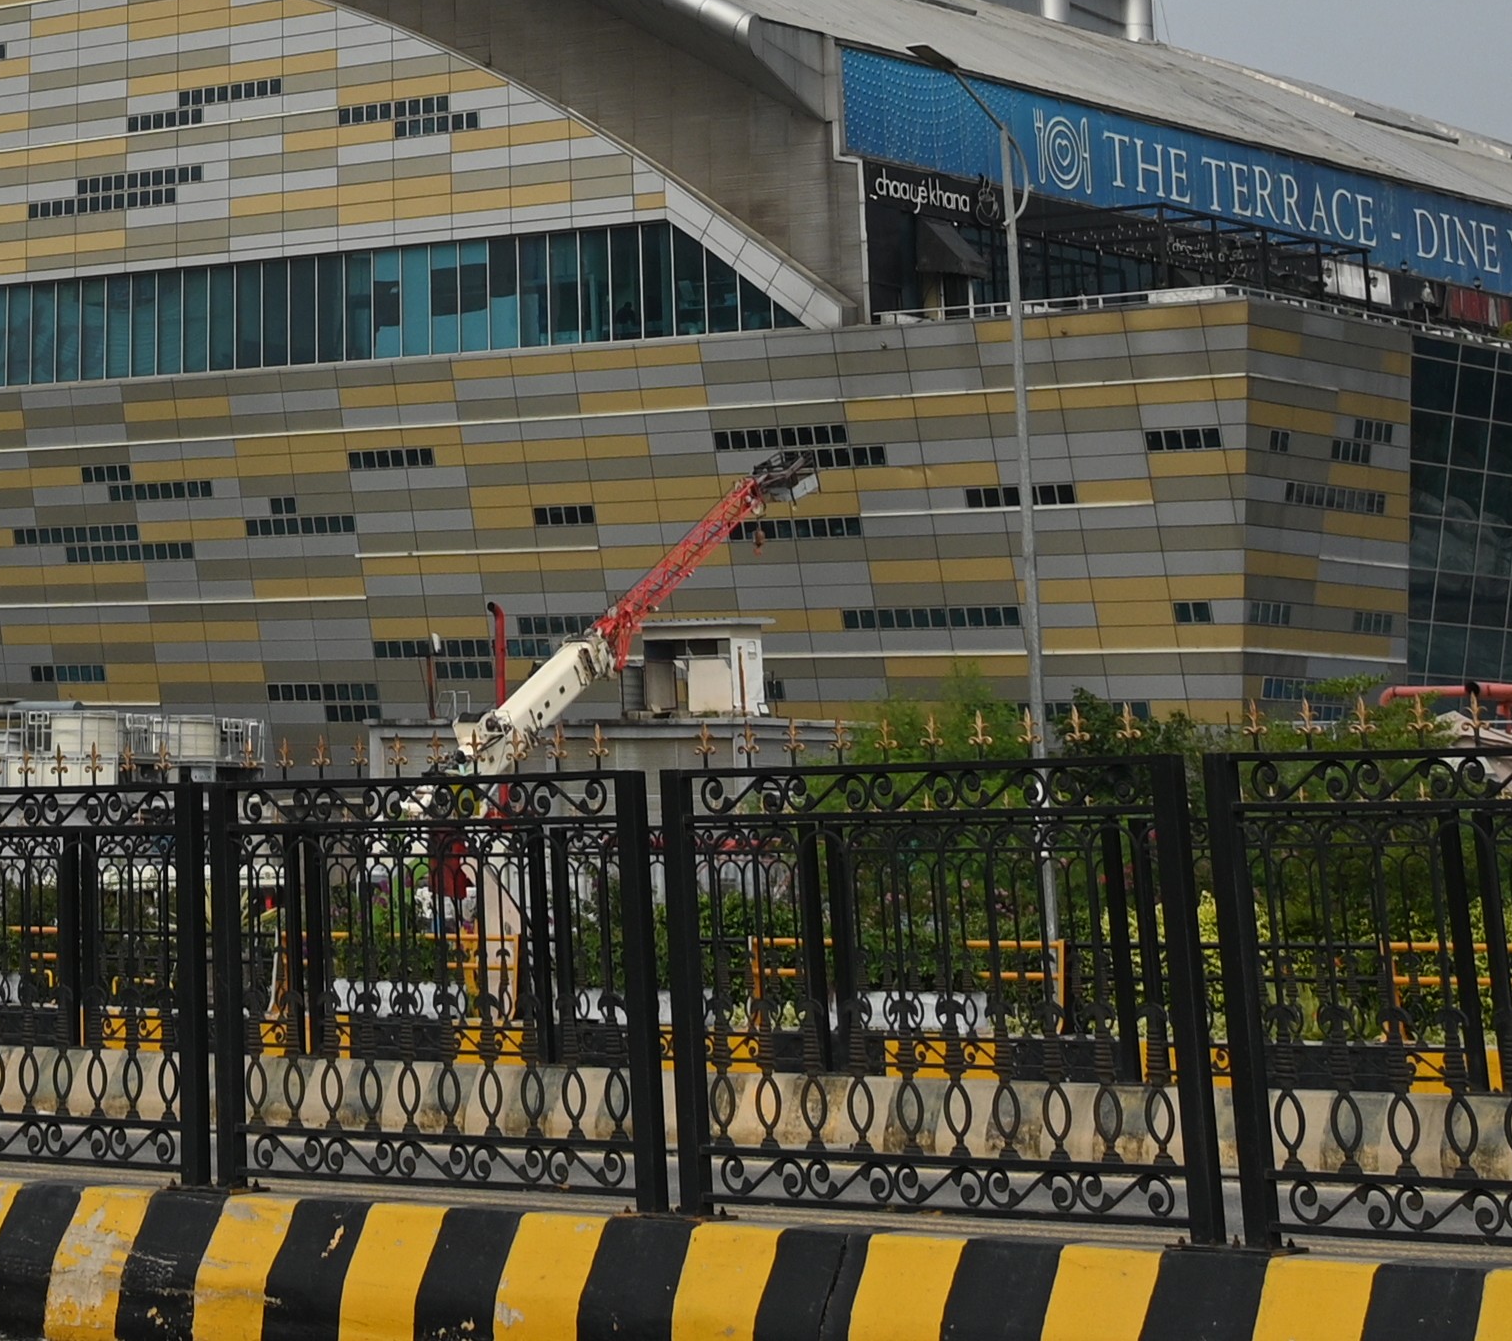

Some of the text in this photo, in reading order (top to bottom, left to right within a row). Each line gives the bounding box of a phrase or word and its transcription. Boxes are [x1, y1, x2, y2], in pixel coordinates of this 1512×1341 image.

[1102, 129, 1192, 204] THE
[1200, 155, 1377, 248] TERRACE
[1412, 207, 1501, 274] DINE
